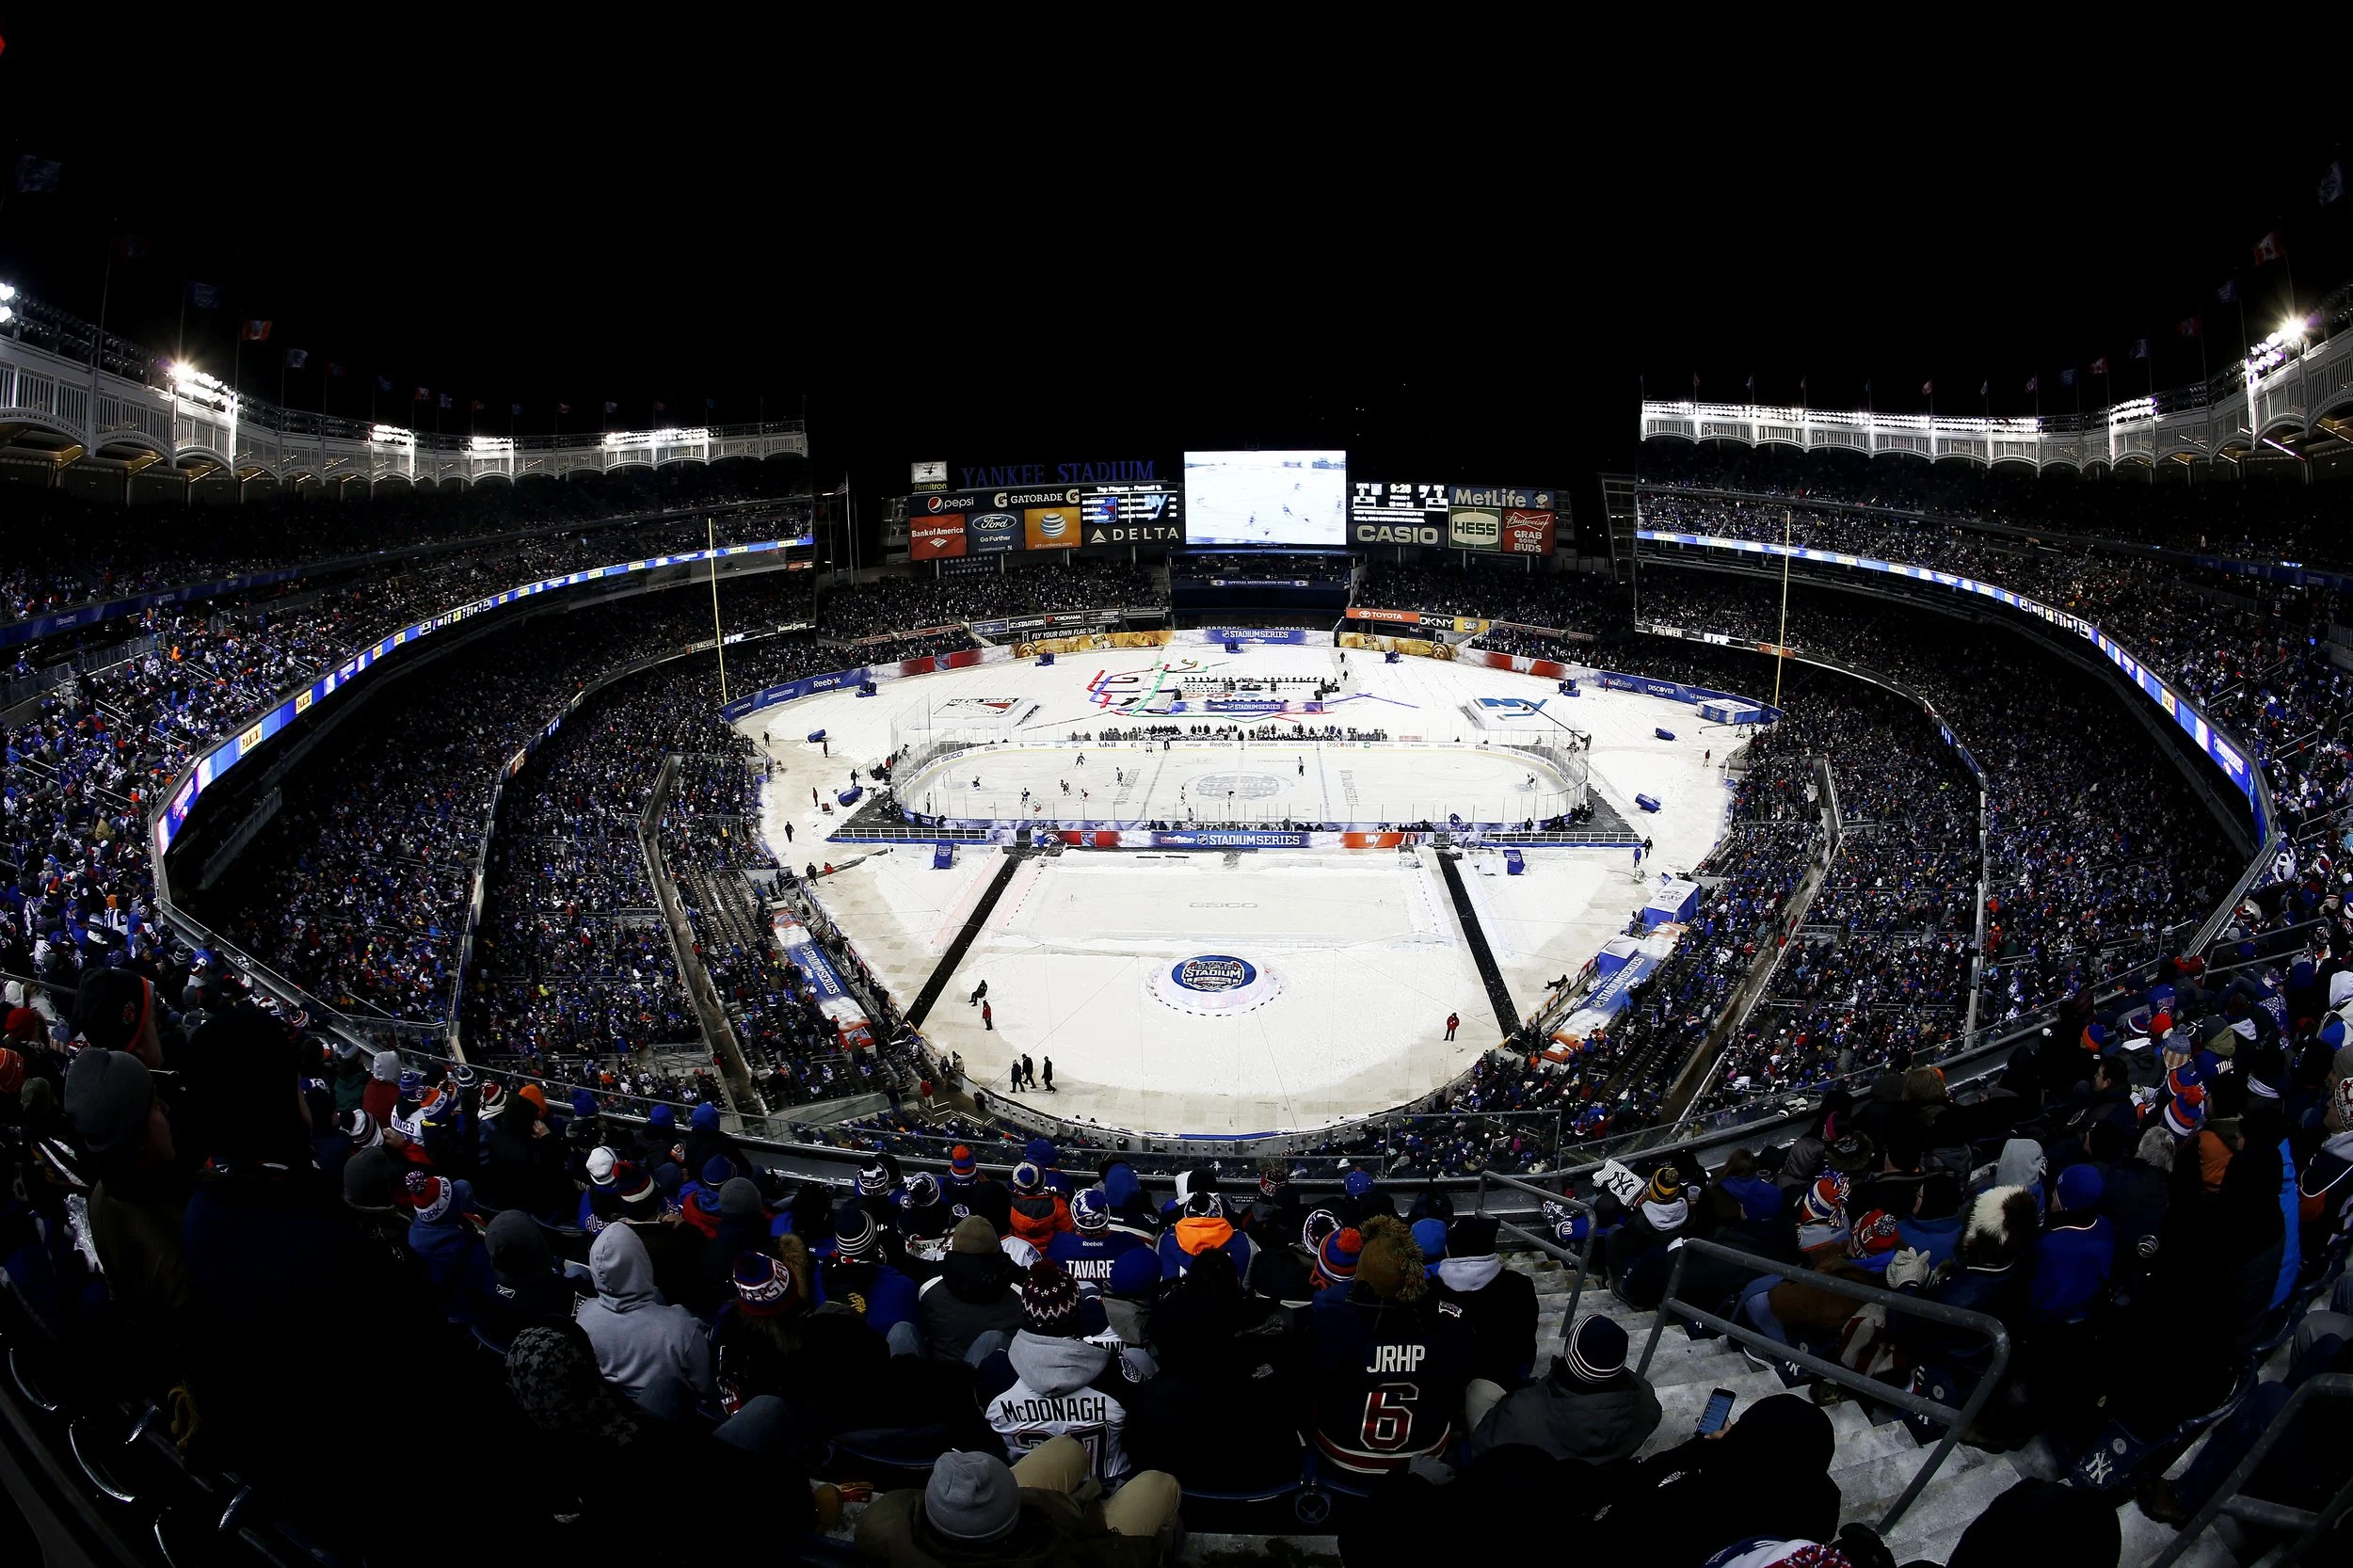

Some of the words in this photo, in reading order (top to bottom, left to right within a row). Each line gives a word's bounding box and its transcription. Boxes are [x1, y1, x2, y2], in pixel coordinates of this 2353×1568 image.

[961, 465, 1046, 488] YANKEE
[1058, 460, 1154, 483] STADIUM
[915, 483, 947, 491] Armitron
[944, 496, 974, 509] pepsi
[1010, 492, 1064, 504] GATORADE
[1454, 488, 1527, 507] MetLife
[981, 516, 1008, 529] Ford
[1506, 516, 1549, 526] Budweiser
[936, 527, 964, 536] America
[1112, 527, 1179, 541] DELTA
[1356, 525, 1439, 545] CASIO
[1454, 521, 1497, 536] HESS
[1513, 530, 1543, 539] GRAB
[1513, 543, 1542, 552] BUDS
[1017, 619, 1045, 628] STARTER
[1419, 616, 1454, 628] DKNY
[1032, 632, 1041, 641] FLY
[1059, 630, 1073, 638] OWN
[1073, 629, 1087, 637] FLAG
[813, 676, 841, 689] Reebok
[1648, 684, 1674, 695] DISCOVER
[734, 703, 751, 713] HONDA
[242, 728, 262, 748] PANINI
[941, 751, 963, 762] GEICO
[1183, 968, 1243, 978] STADIUM
[392, 1114, 415, 1135] TAVARES
[441, 1179, 451, 1200] NEW
[419, 1203, 443, 1221] YORK
[1367, 1344, 1426, 1373] JRHP
[1000, 1396, 1106, 1423] McDONAGH
[1360, 1382, 1419, 1451] 6
